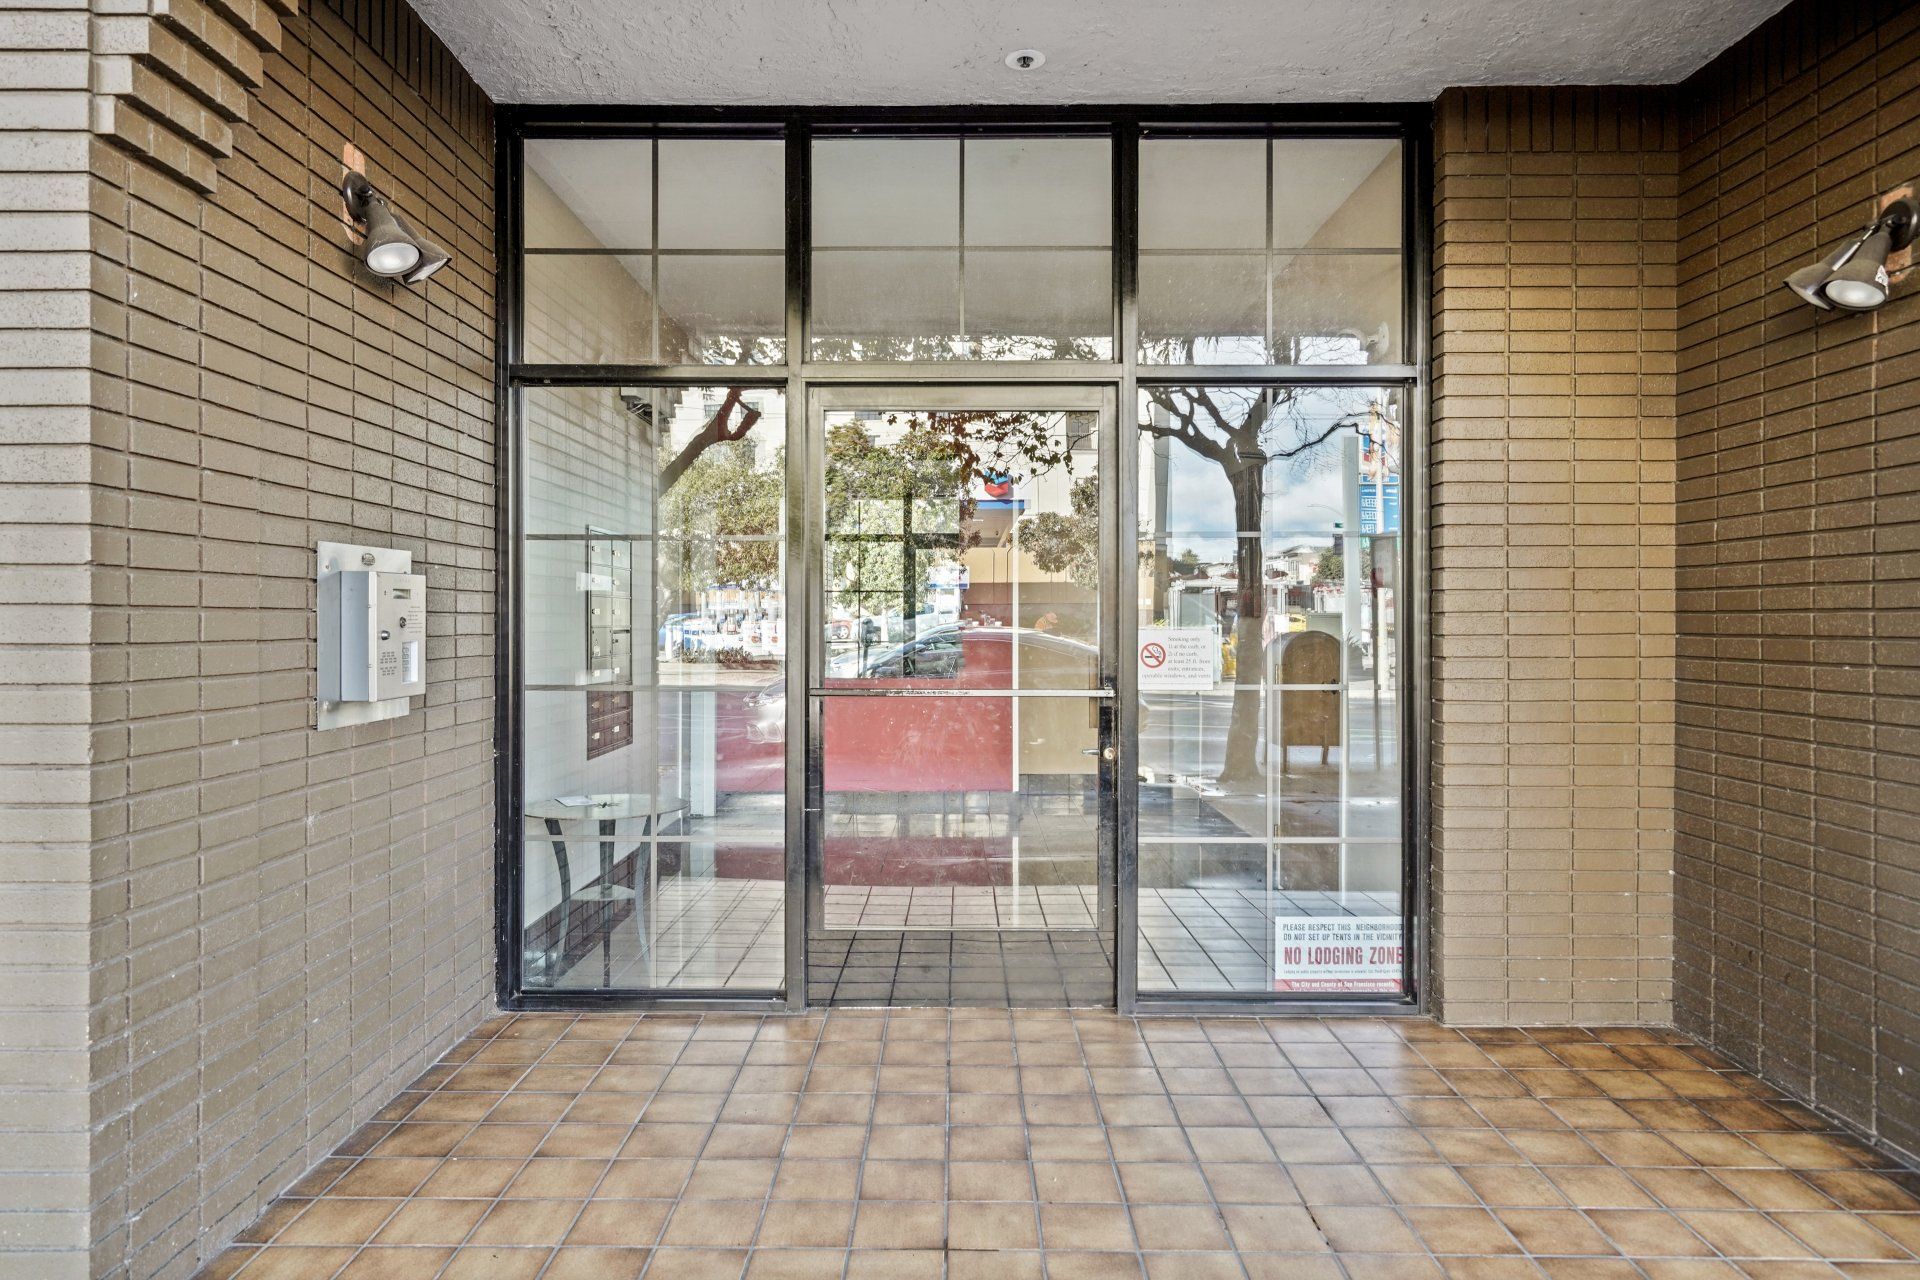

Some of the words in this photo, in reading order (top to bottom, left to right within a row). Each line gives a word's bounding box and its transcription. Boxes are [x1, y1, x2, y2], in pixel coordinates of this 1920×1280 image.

[1284, 946, 1302, 965] NO
[1308, 946, 1363, 965] LODGING
[1370, 946, 1403, 965] ZONE
